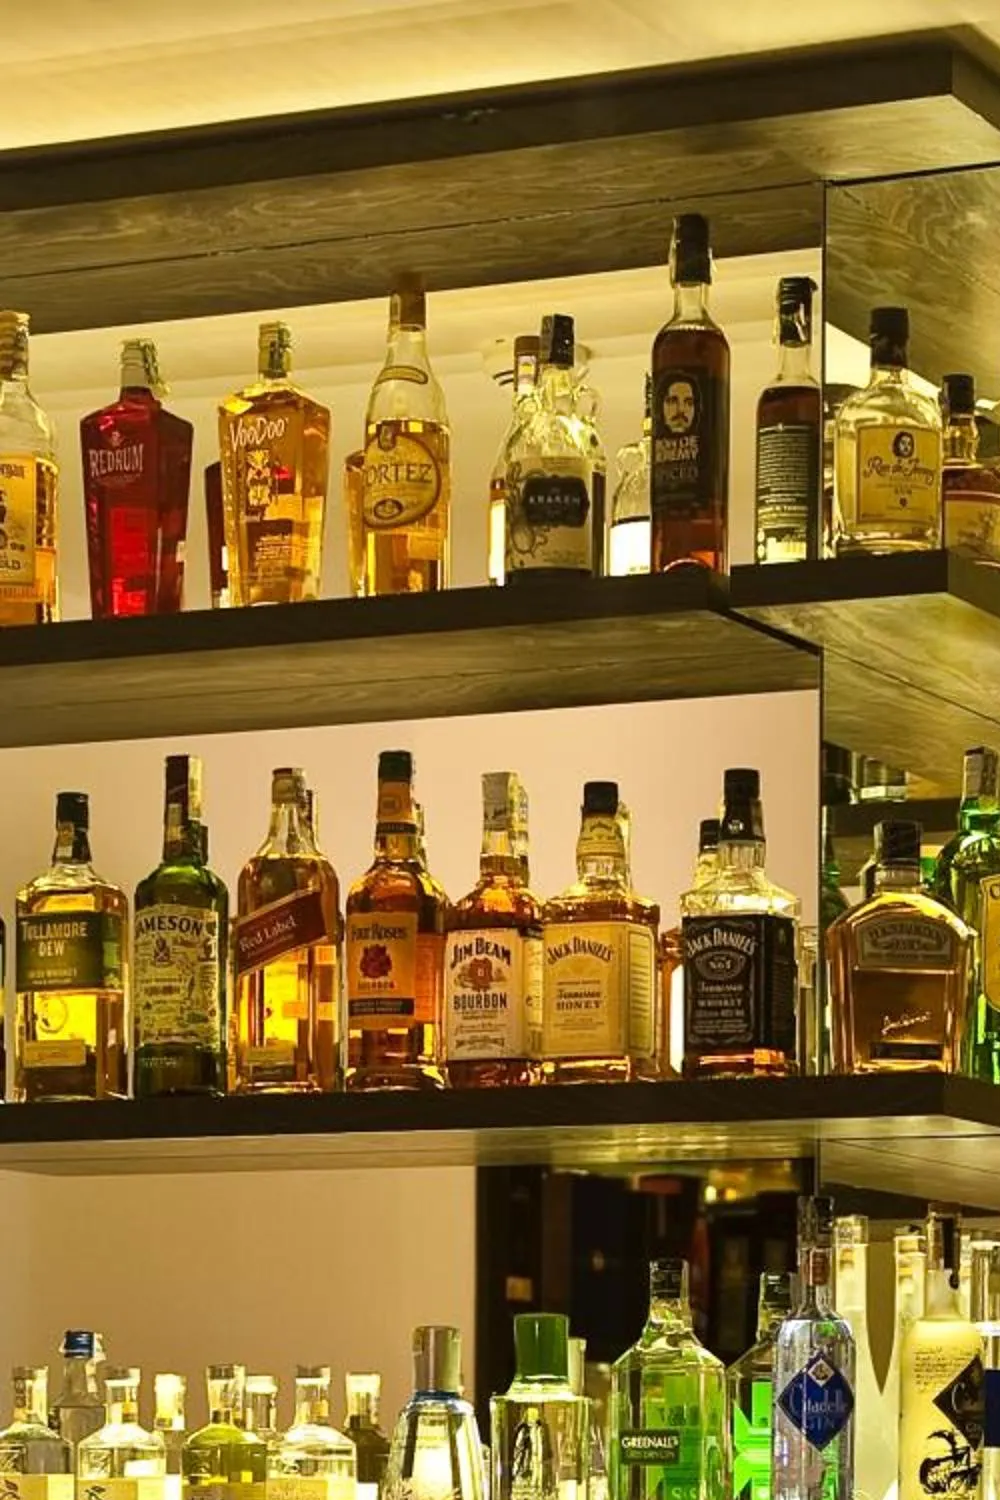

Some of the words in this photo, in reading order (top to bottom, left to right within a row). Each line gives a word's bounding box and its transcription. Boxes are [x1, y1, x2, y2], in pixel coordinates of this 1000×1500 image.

[229, 416, 285, 452] VooDoo
[89, 443, 144, 478] REDRUM
[365, 463, 433, 486] ORTEZ
[21, 920, 88, 940] TULLAMORE
[239, 931, 263, 953] Red
[264, 915, 297, 940] Label
[450, 942, 474, 969] JIM
[474, 937, 511, 967] BEAM
[547, 942, 572, 965] JACK
[686, 932, 713, 958] JACK
[453, 992, 508, 1009] BOURBON
[556, 1000, 602, 1010] HONEY
